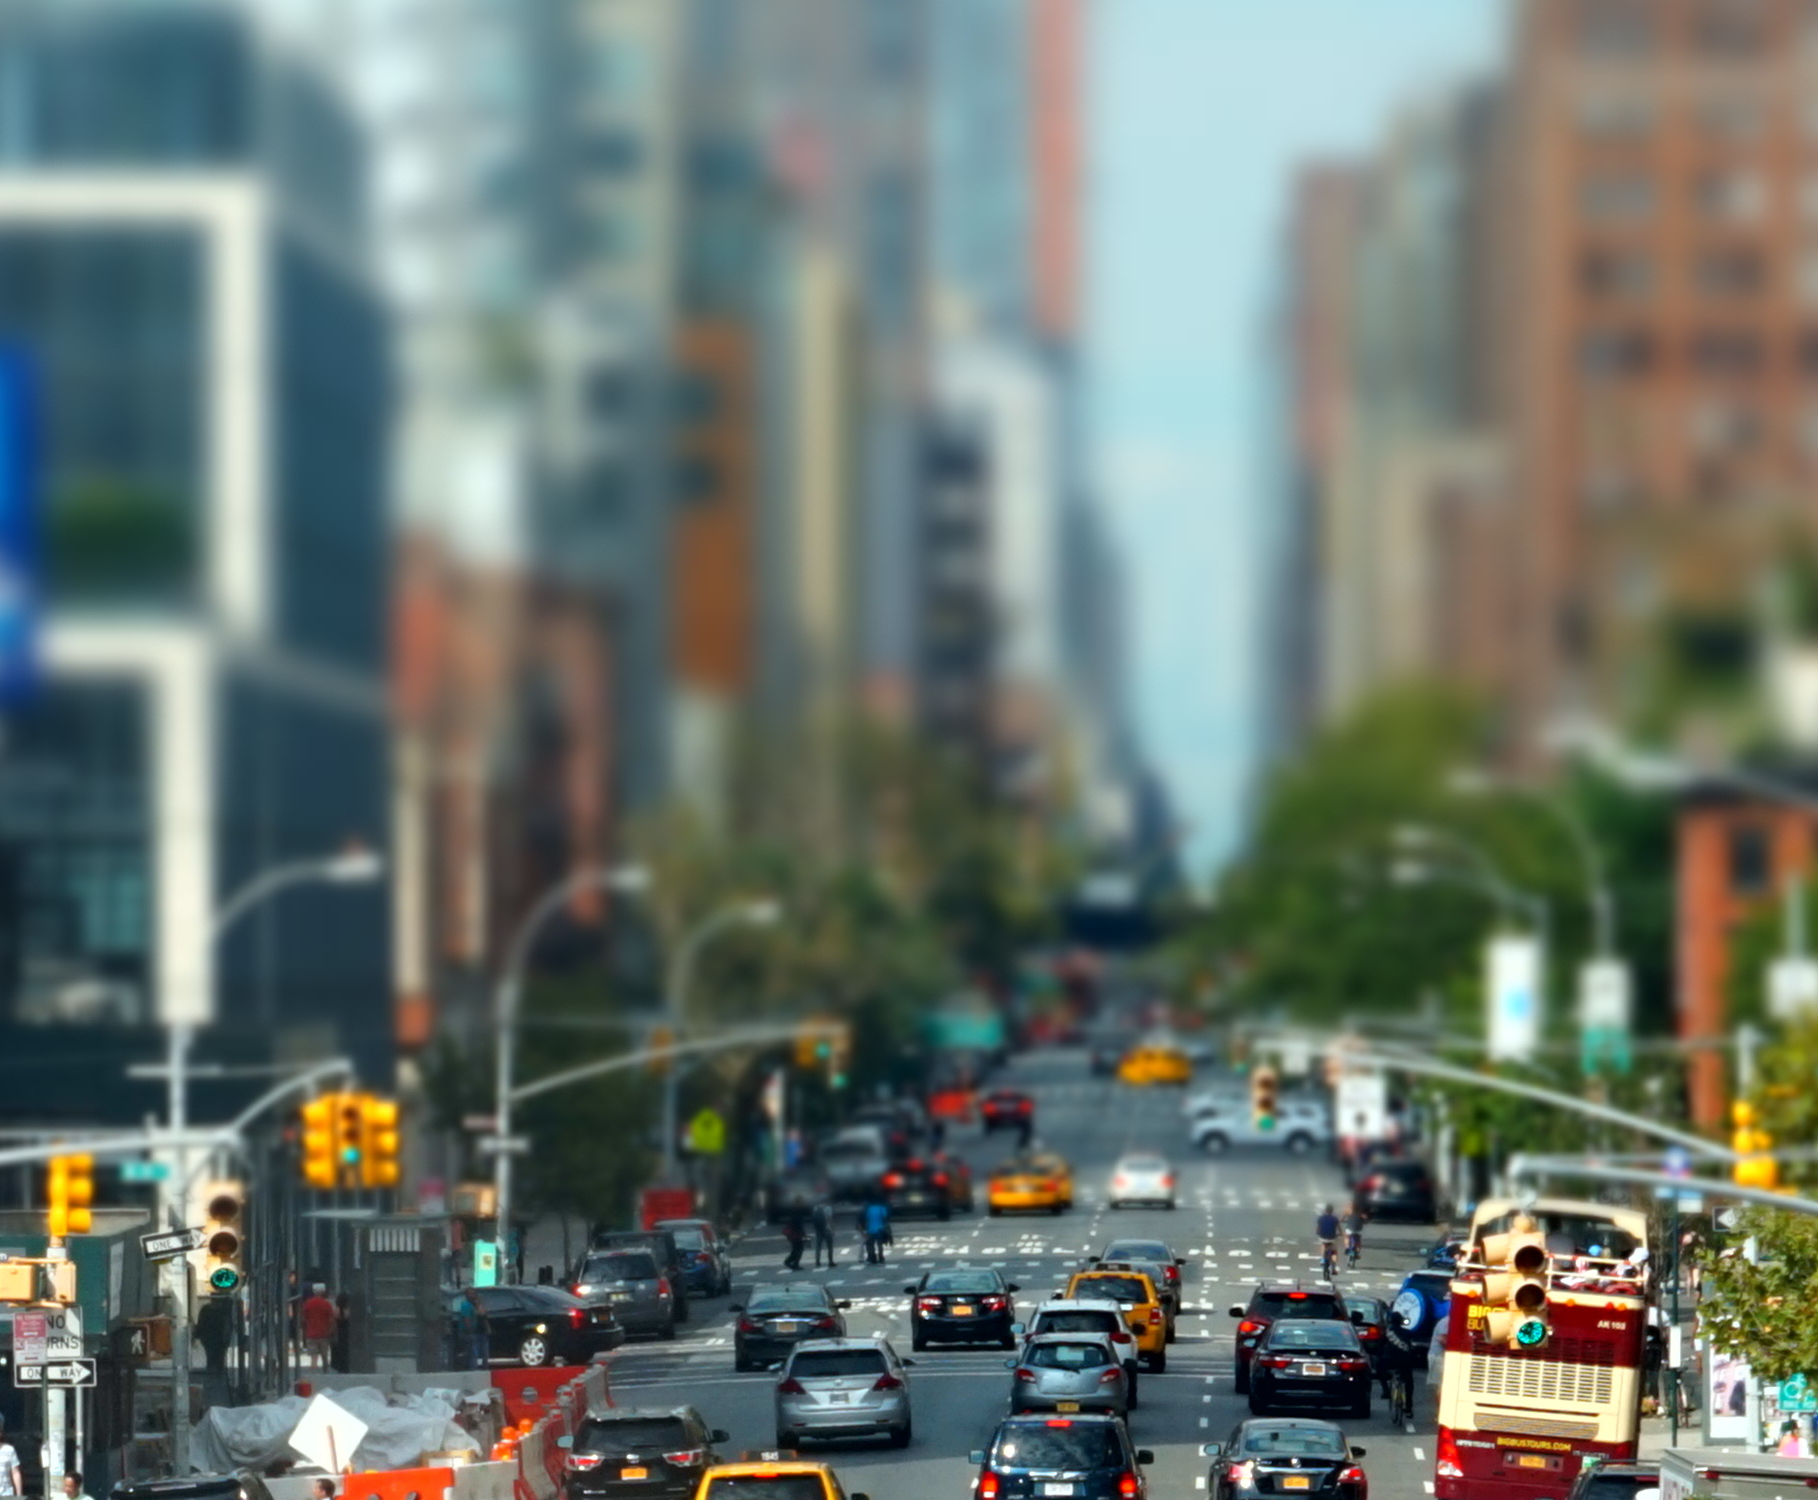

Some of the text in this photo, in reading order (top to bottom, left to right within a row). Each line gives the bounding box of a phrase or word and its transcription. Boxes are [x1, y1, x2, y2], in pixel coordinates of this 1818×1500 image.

[153, 1240, 173, 1251] ONE
[47, 1315, 66, 1329] NO
[1467, 1318, 1485, 1330] BU
[27, 1368, 82, 1378] ON WAY
